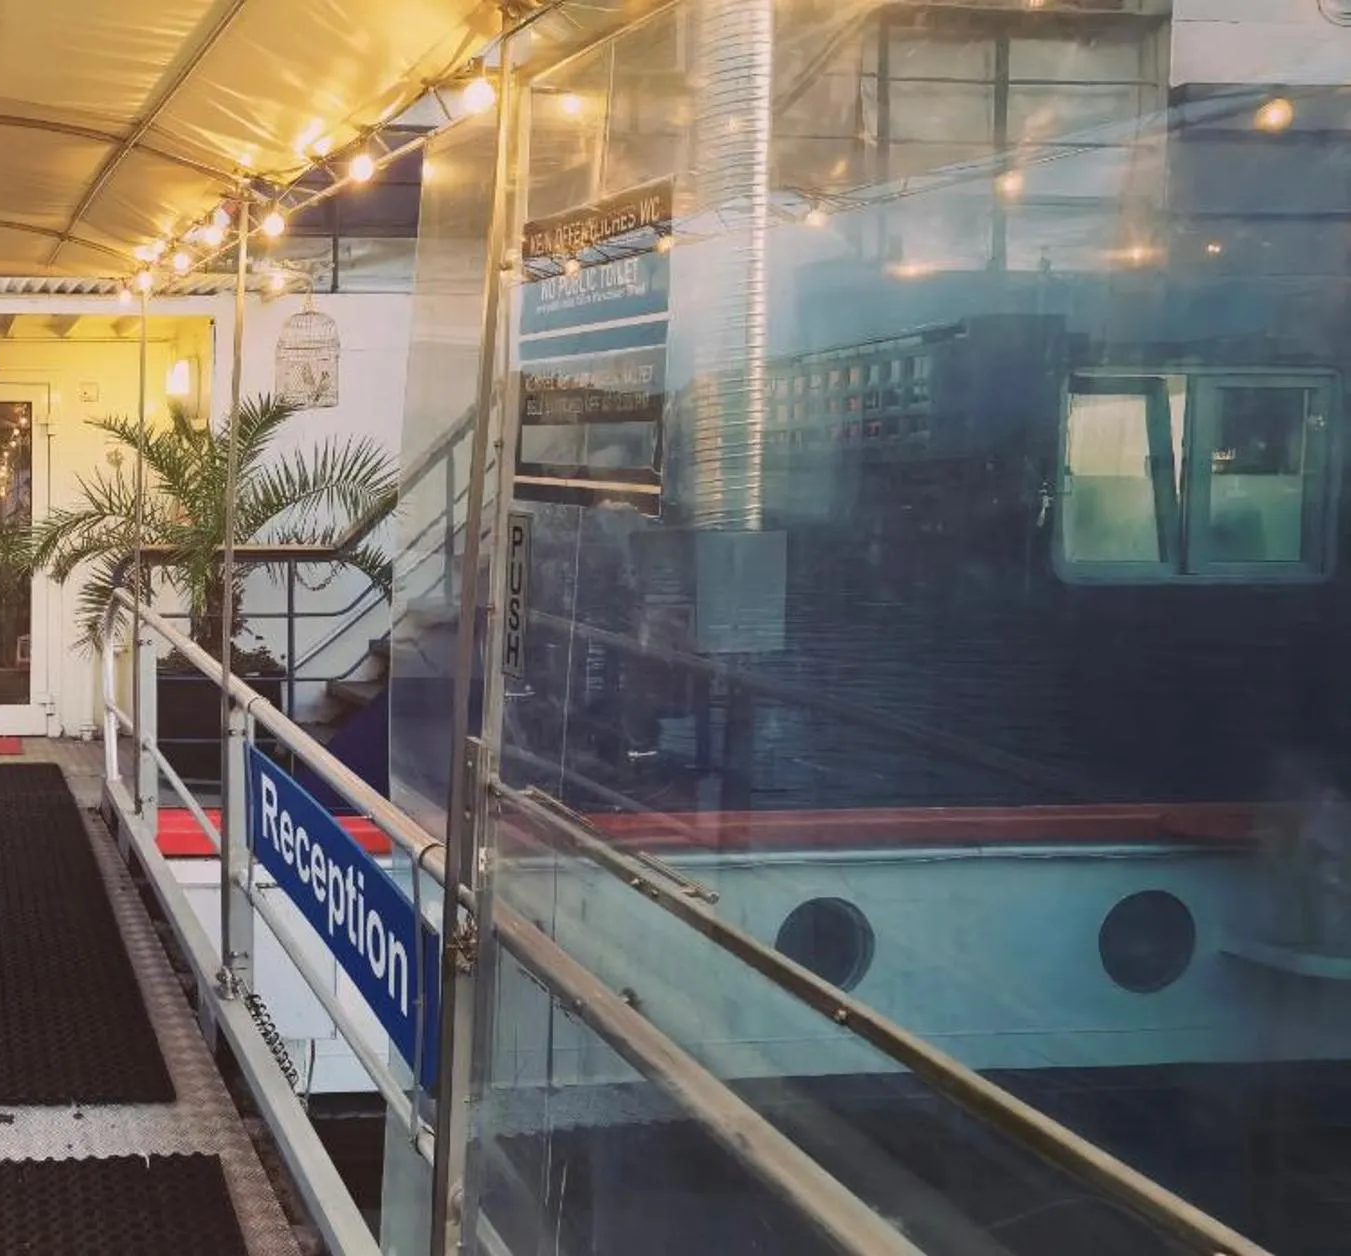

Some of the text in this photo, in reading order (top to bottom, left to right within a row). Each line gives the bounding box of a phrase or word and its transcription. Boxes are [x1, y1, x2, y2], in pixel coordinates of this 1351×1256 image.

[640, 196, 660, 226] WC
[540, 279, 556, 301] NO
[558, 267, 597, 299] PUBLIC
[600, 257, 639, 289] TOILET
[506, 525, 524, 668] PUSH
[259, 773, 408, 1018] Reception
